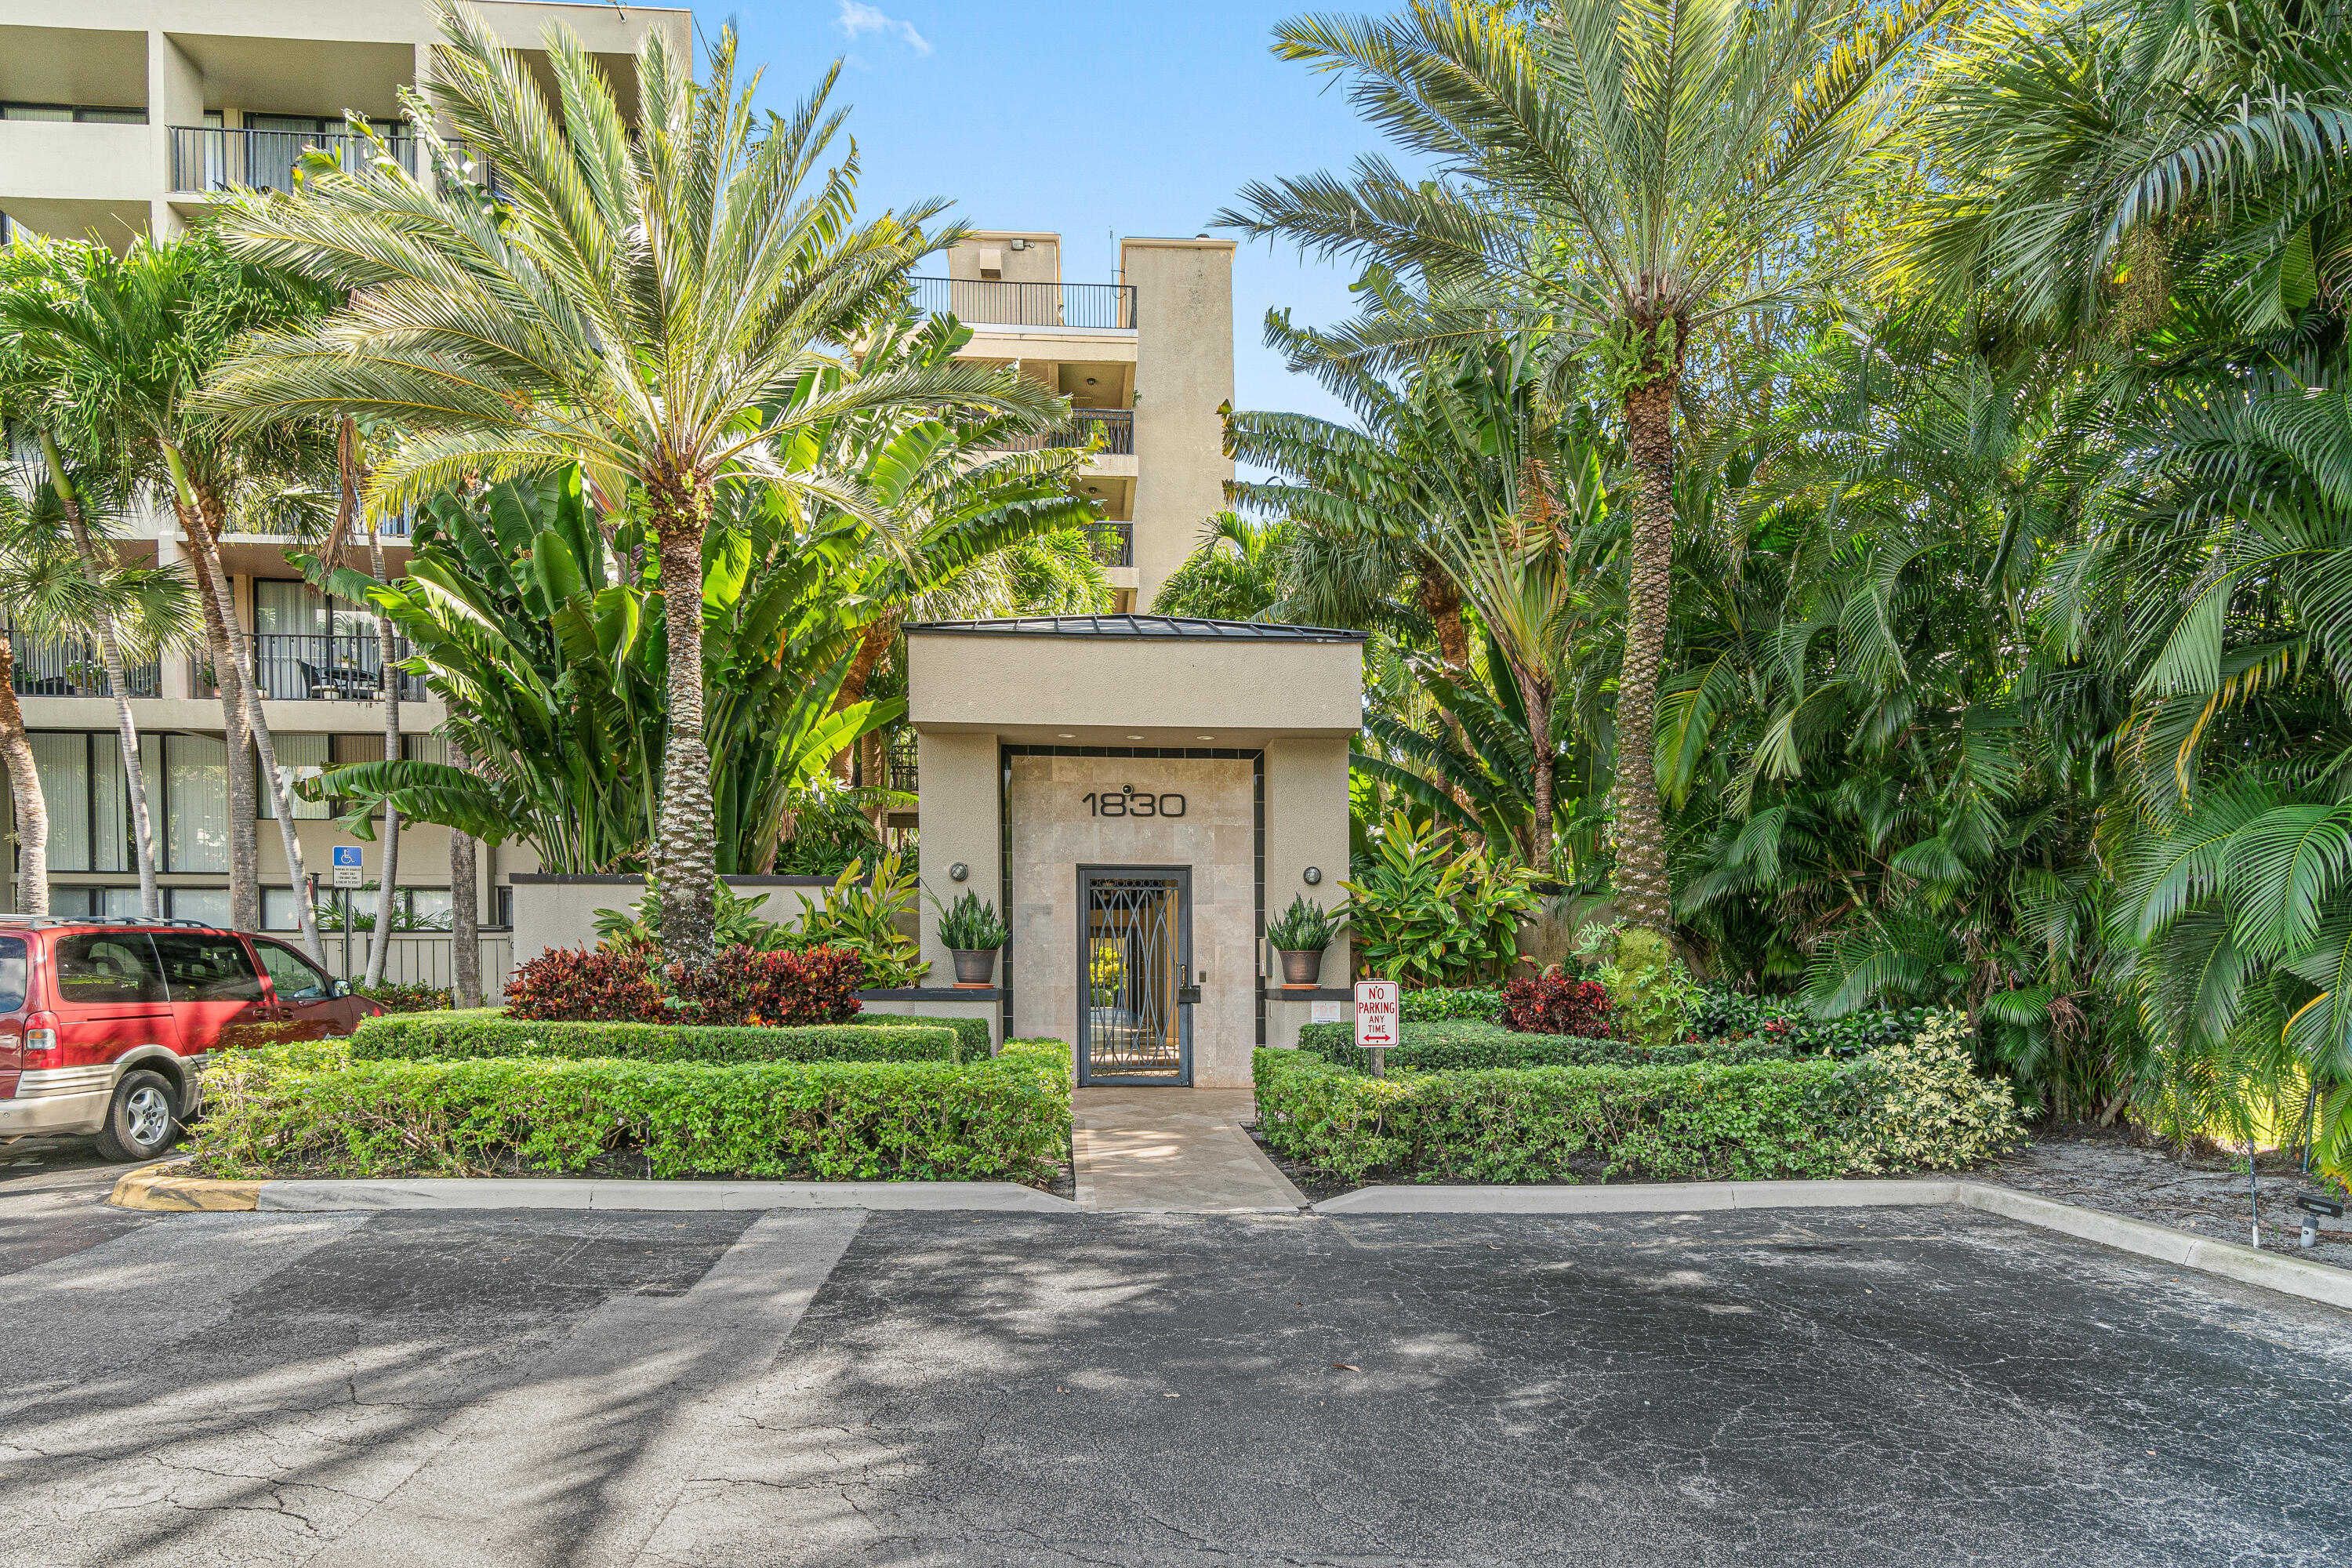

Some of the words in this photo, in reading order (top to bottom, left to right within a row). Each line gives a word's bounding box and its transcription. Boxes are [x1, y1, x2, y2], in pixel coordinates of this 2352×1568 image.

[1082, 793, 1185, 817] 1830
[1369, 988, 1384, 1000] NO
[1359, 1002, 1395, 1014] PARKING
[1369, 1015, 1385, 1024] ANY
[1368, 1025, 1386, 1033] TIME
